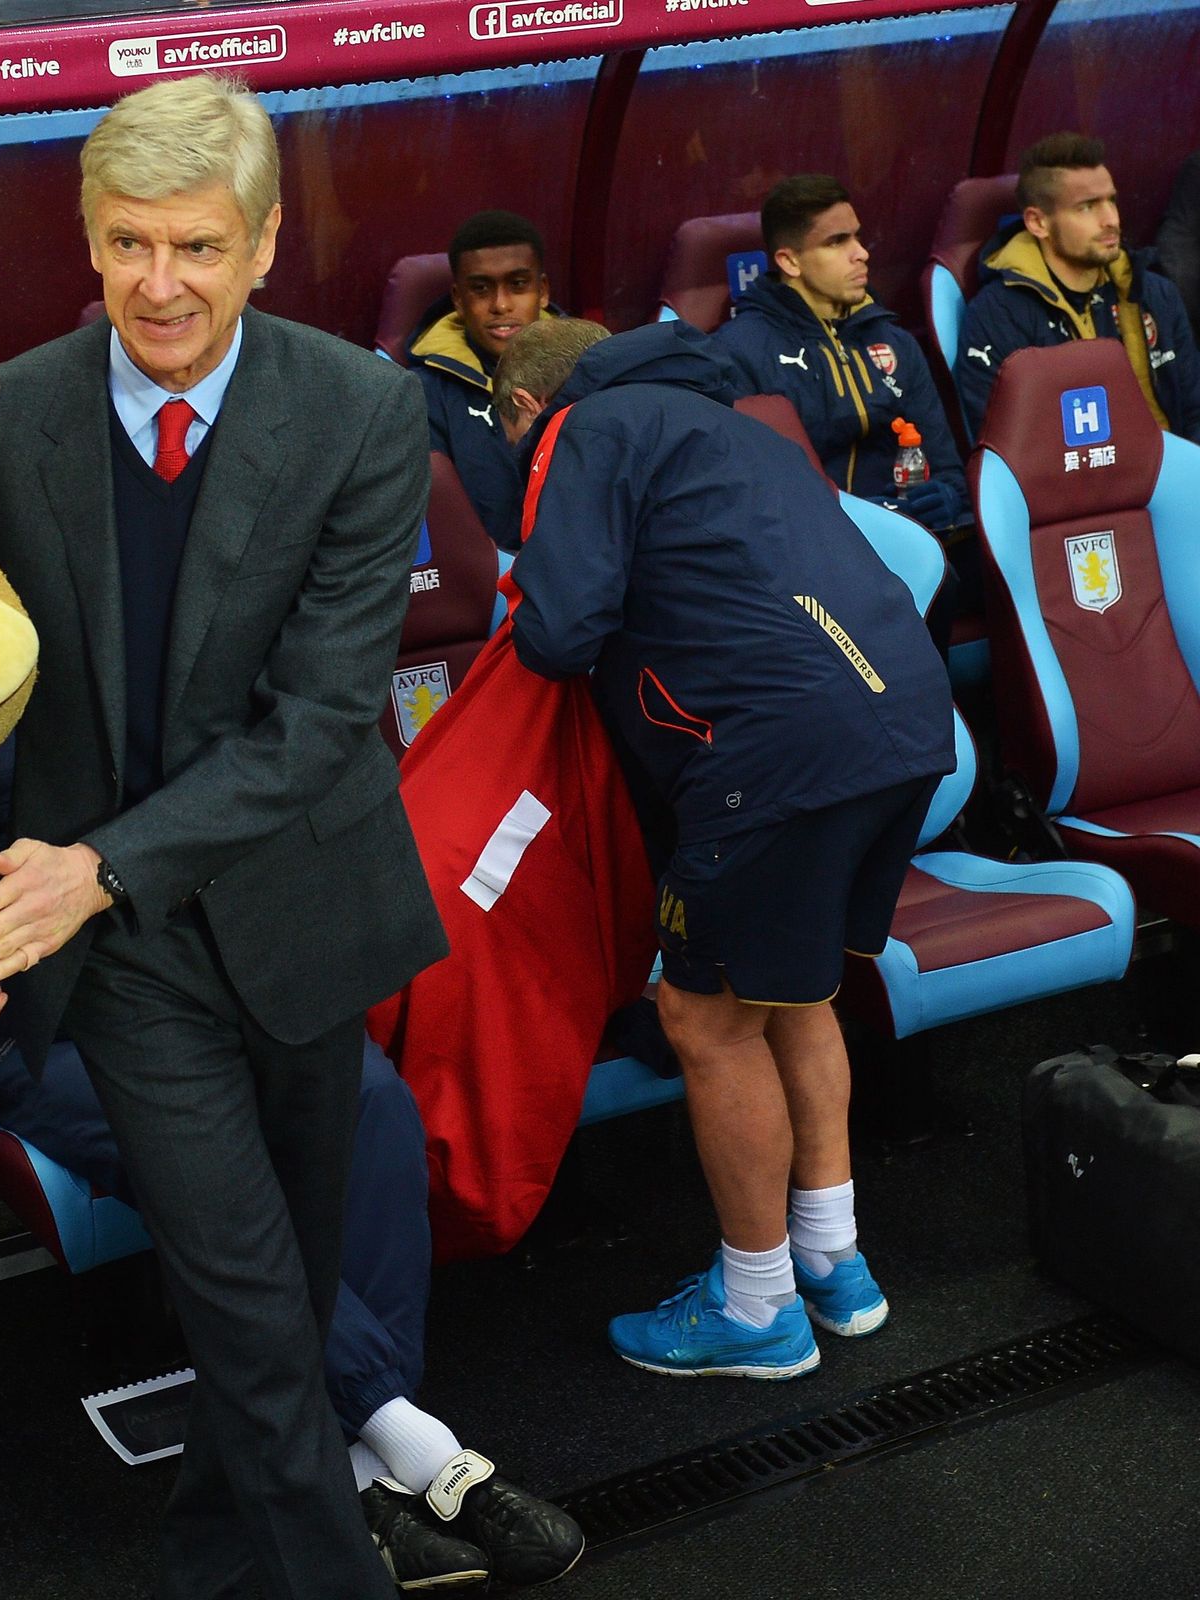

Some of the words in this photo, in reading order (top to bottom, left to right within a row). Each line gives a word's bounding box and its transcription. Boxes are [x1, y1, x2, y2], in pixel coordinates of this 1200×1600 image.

[511, 0, 614, 28] avfcofficial
[332, 22, 426, 46] #avfclive
[163, 34, 277, 64] avfcofficial
[1072, 538, 1109, 554] AVFC
[829, 625, 874, 680] GUNNERS
[398, 669, 441, 690] AVFC
[443, 1466, 470, 1496] PUMA
